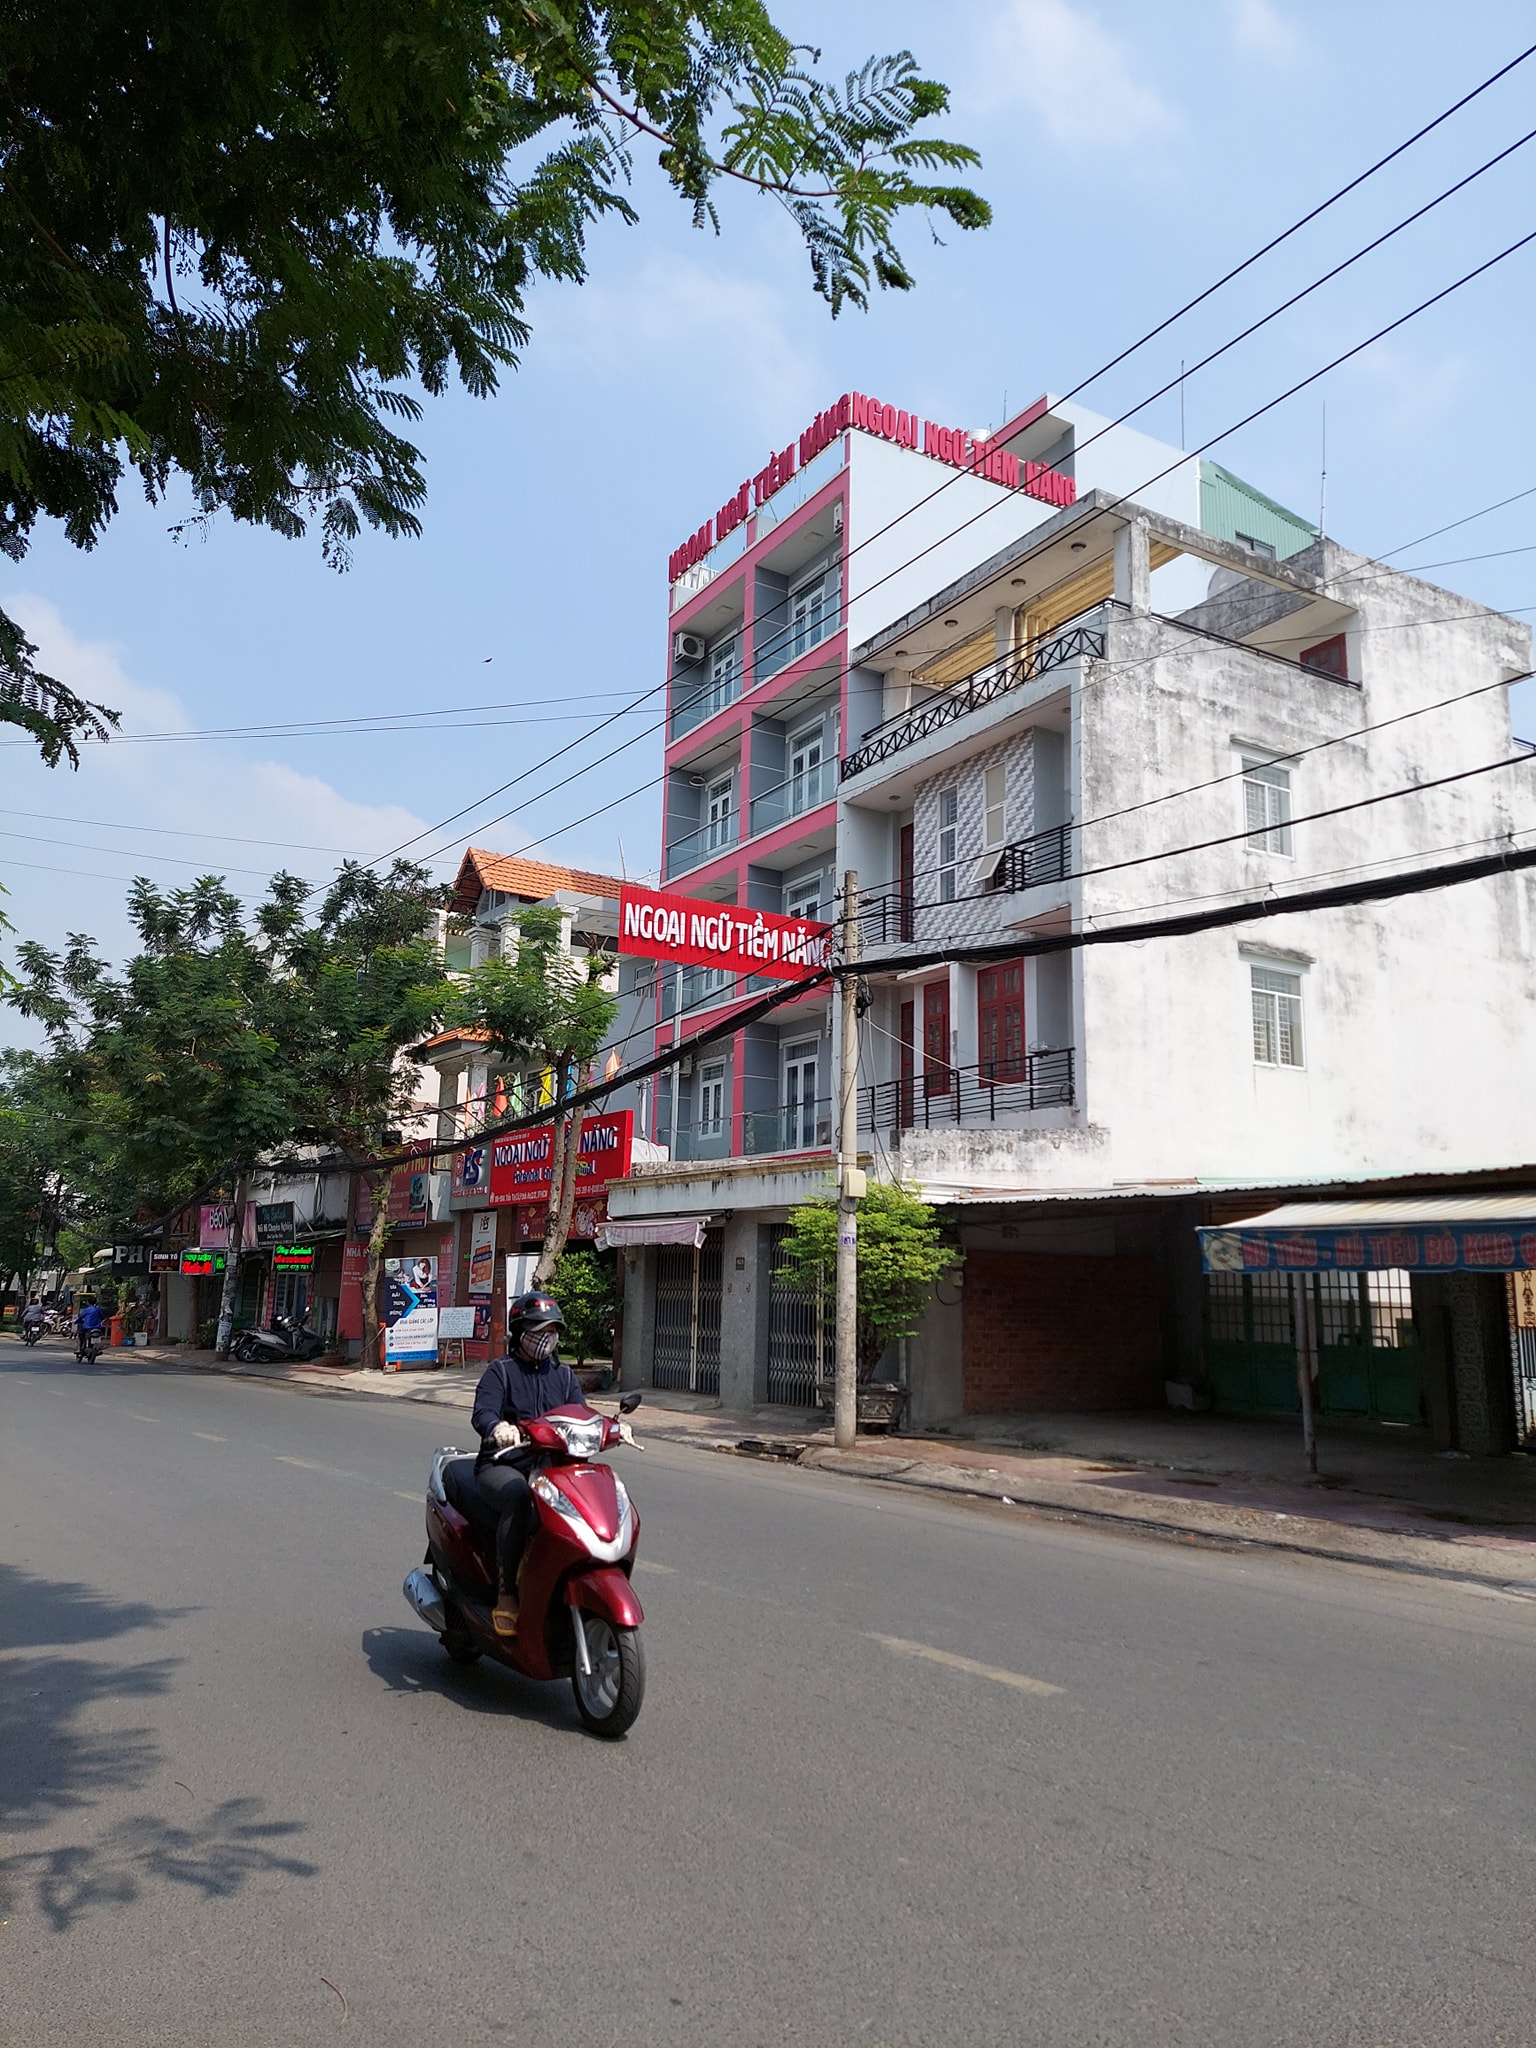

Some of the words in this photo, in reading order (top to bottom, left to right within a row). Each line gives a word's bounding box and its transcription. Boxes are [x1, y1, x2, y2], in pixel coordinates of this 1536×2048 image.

[852, 391, 918, 449] NGOẠI
[924, 421, 968, 467] NGỮ
[972, 436, 1019, 487] TIỀM
[1024, 460, 1077, 507] NĂNG
[669, 518, 713, 583] NGOẠI
[716, 479, 751, 541] NGỮ
[753, 450, 796, 507] TIỀM
[800, 392, 851, 466] NĂNG
[624, 902, 686, 948] NGOẠI
[690, 912, 735, 952] NGỮ
[735, 912, 778, 961] TIỀM
[494, 1143, 526, 1168] NGOẠI
[526, 1133, 551, 1162] NGỮ
[583, 1123, 618, 1153] NĂNG
[153, 1253, 169, 1261] SINH
[1424, 1225, 1457, 1266] BÒ
[1462, 1232, 1514, 1266] KHO
